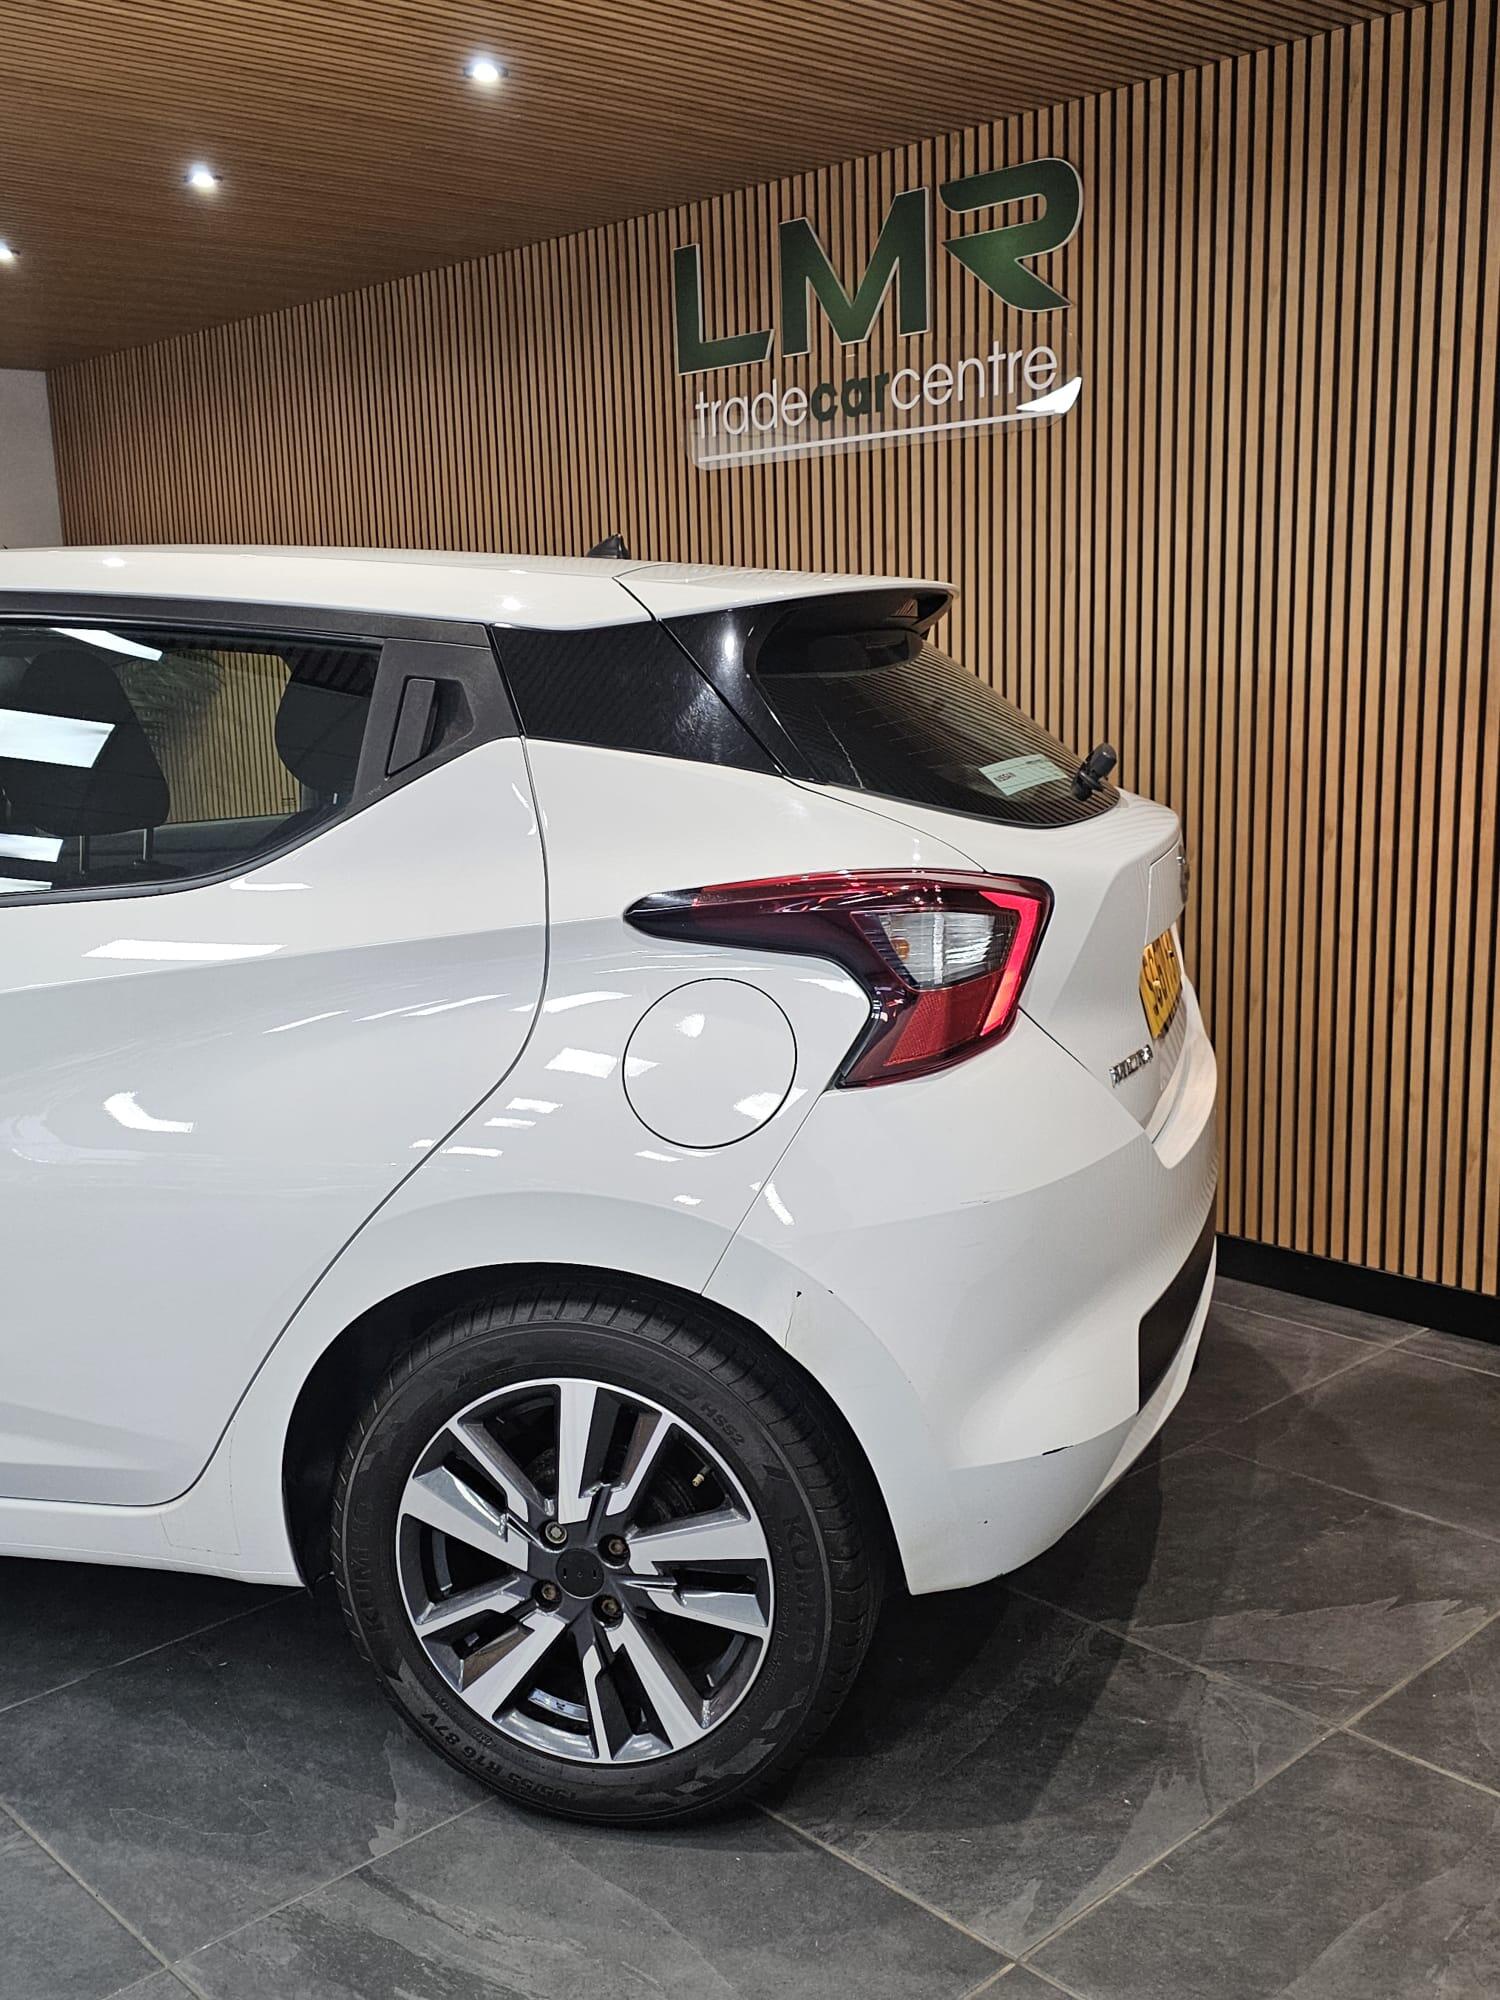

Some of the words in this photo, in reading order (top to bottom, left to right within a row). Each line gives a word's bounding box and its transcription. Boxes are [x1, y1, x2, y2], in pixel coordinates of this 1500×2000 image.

[673, 157, 1083, 376] LMR
[422, 1713, 461, 1745] 87V
[463, 1746, 503, 1776] R16
